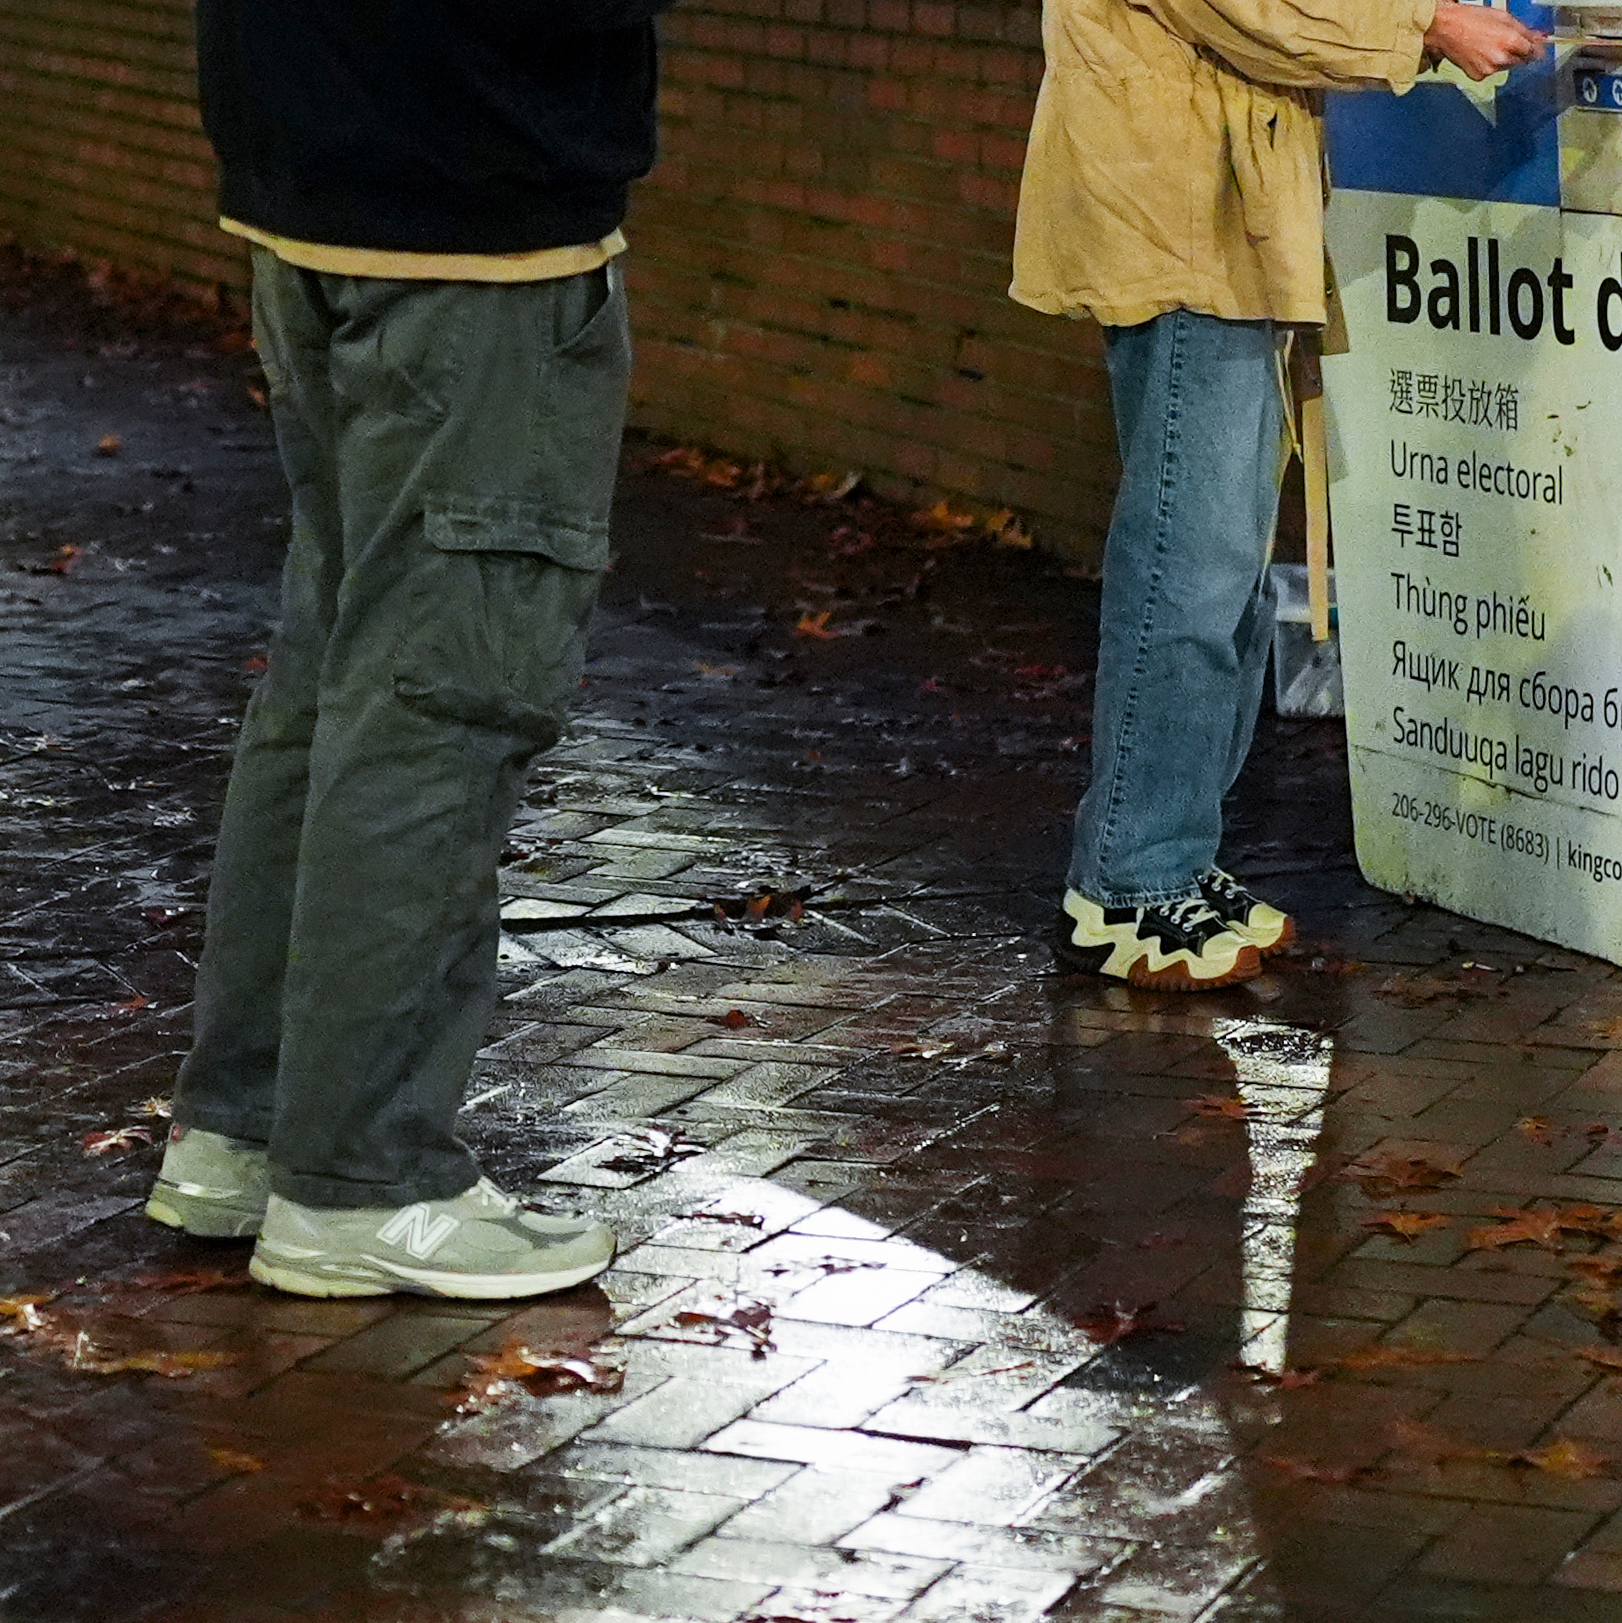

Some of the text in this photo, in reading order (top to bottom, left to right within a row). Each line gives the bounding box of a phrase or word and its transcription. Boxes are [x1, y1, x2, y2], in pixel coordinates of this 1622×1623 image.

[1386, 234, 1575, 346] Ballot
[1389, 367, 1520, 431] 選票投放箱
[1390, 439, 1563, 505] Urna electoral
[1391, 503, 1463, 557] 투표함
[1390, 571, 1546, 641] Thùng phiếu
[1392, 640, 1460, 693] Ящик
[1467, 666, 1511, 706] для
[1519, 671, 1594, 730] сбора
[1393, 706, 1507, 780] Sanduuqa
[1515, 734, 1564, 794] lagu
[1572, 752, 1620, 801] rido
[1391, 792, 1496, 845] 206-296-VOTE
[1500, 822, 1550, 866] (8683)
